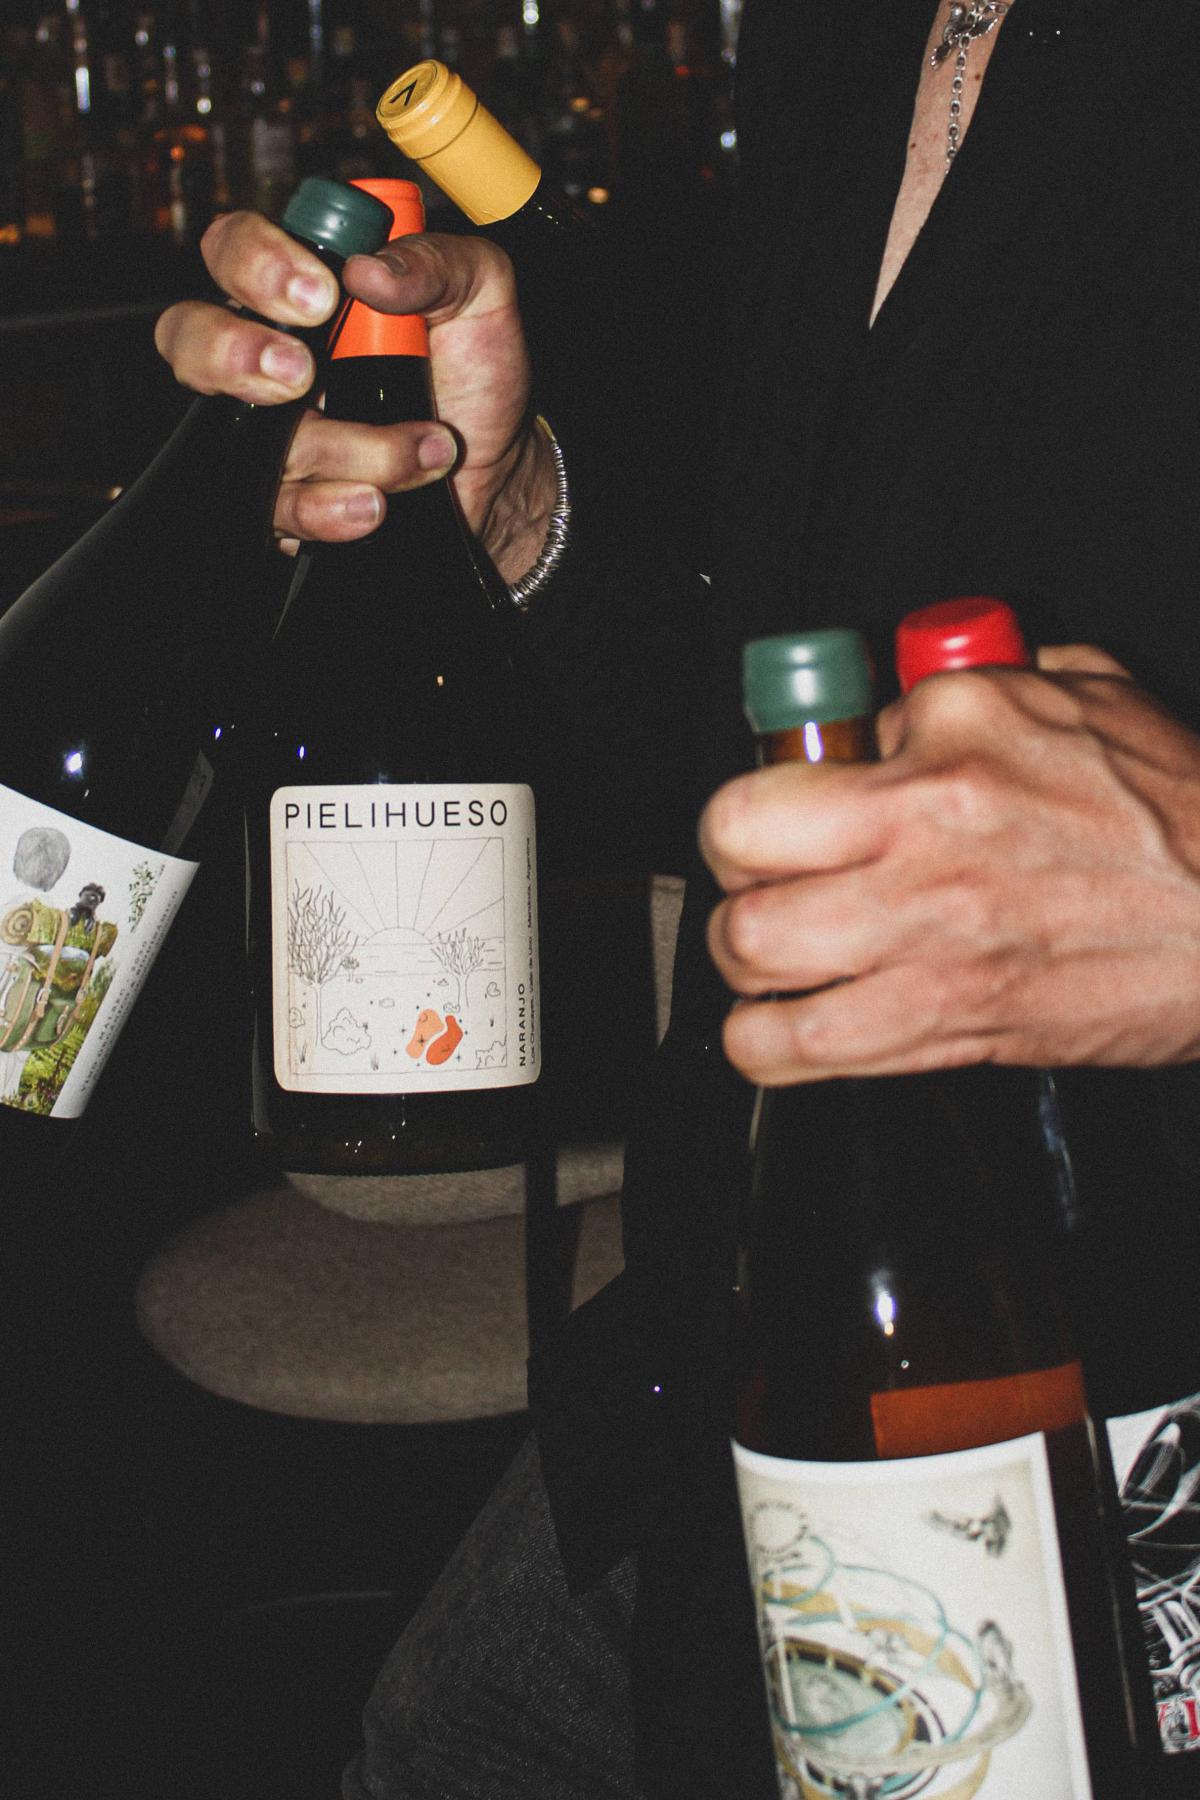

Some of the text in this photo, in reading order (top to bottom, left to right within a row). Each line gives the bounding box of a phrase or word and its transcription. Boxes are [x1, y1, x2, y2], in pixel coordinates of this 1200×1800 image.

[285, 799, 508, 829] PIELIHUESO
[99, 988, 126, 1041] MALBEC
[518, 983, 526, 1067] NARANJO
[81, 1061, 98, 1093] VINO
